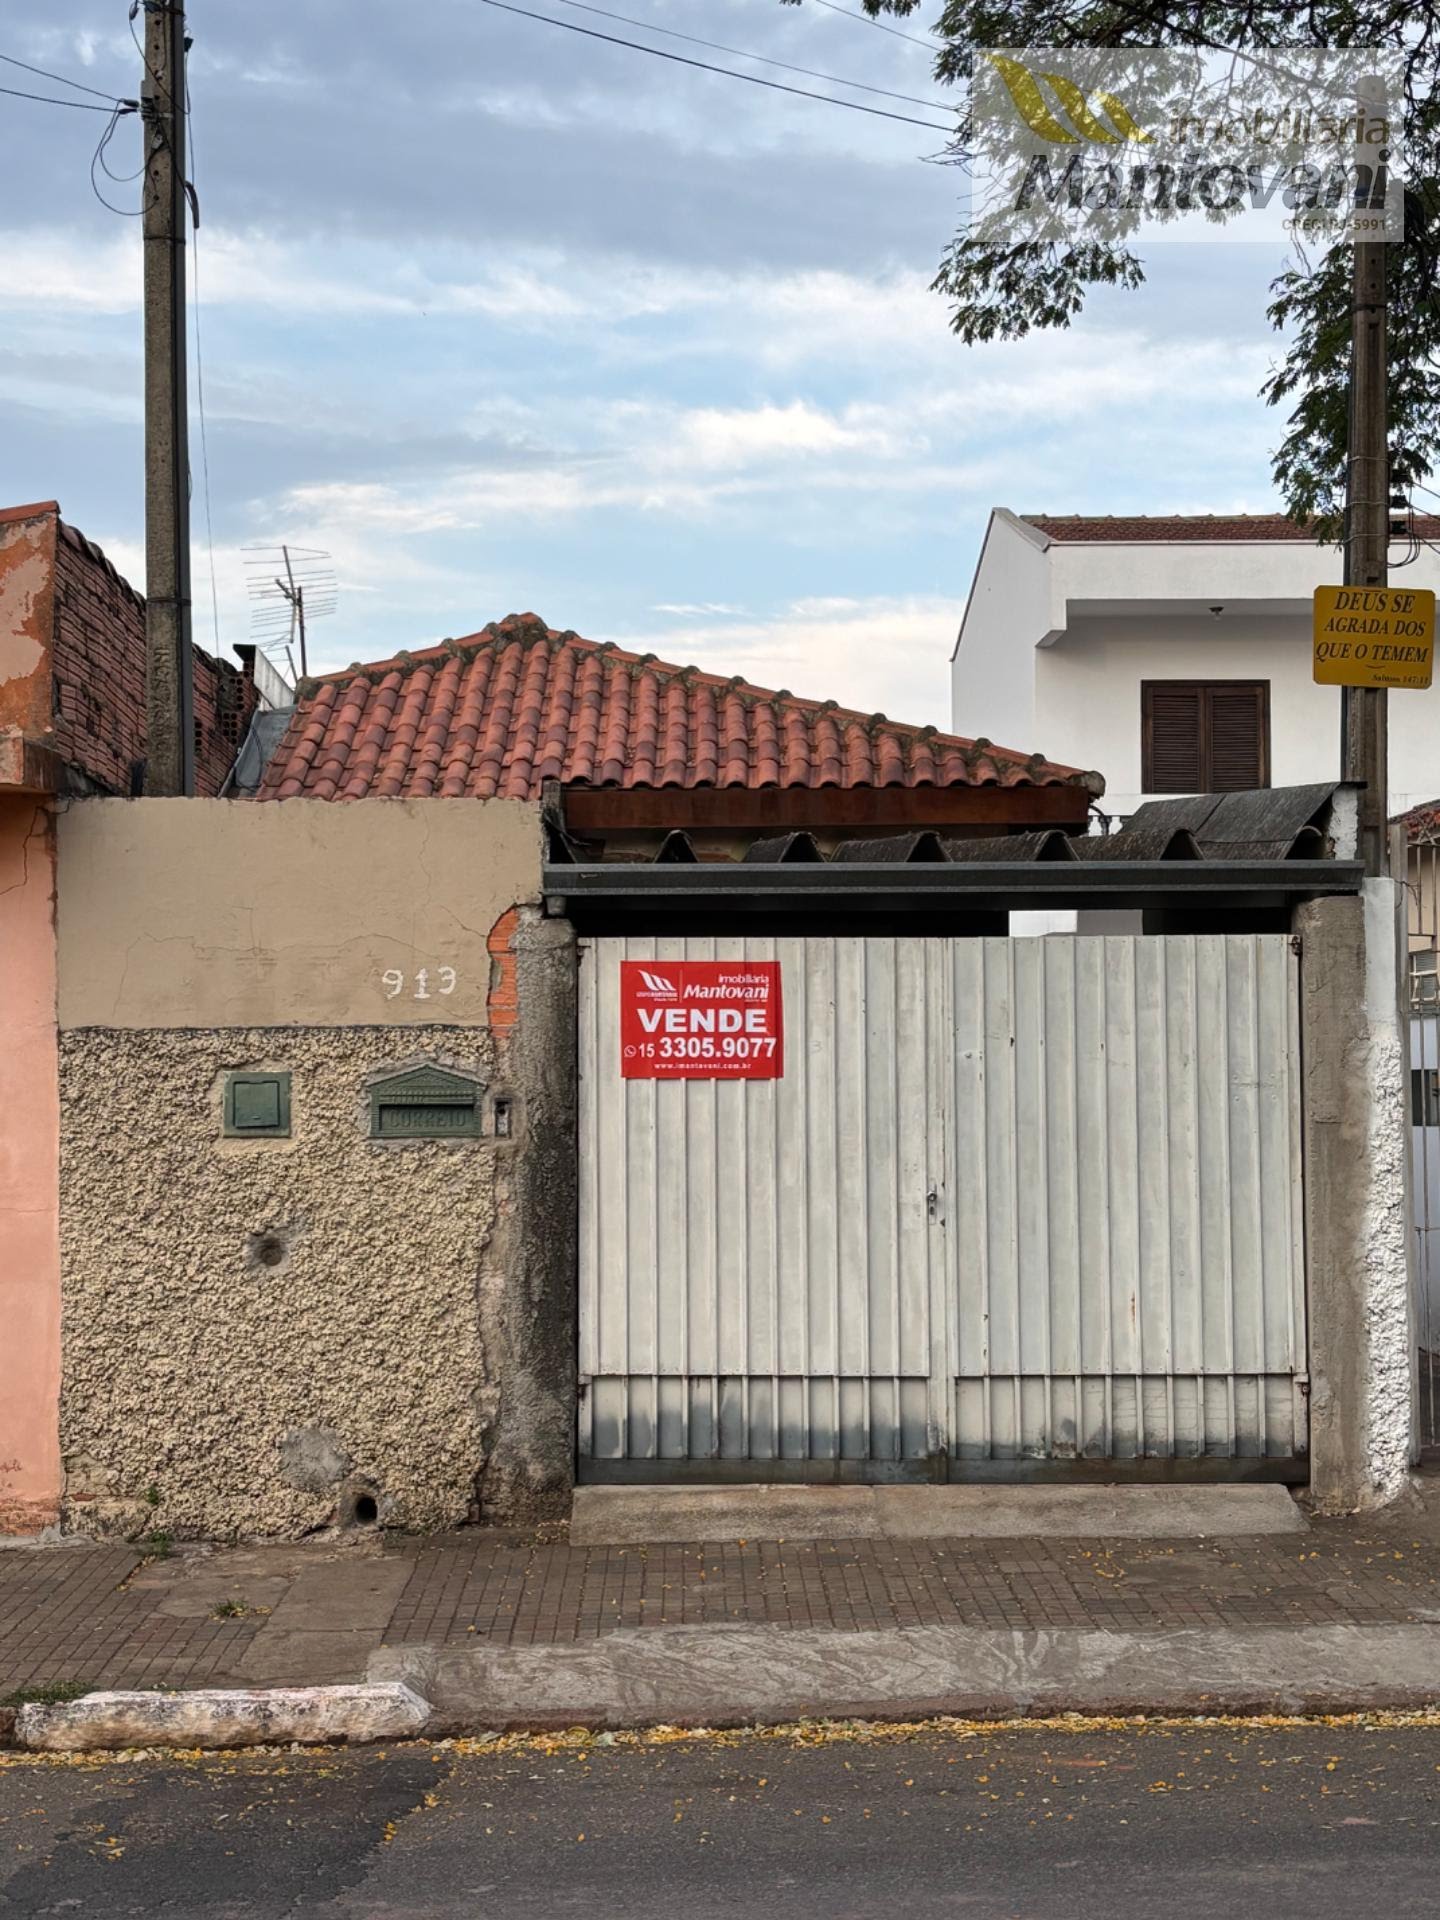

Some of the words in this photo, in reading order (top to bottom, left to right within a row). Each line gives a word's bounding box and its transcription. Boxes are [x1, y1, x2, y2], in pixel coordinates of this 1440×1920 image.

[1334, 591, 1389, 612] DEUS
[1391, 594, 1416, 614] SE
[1323, 616, 1389, 635] AGRADA
[1394, 620, 1426, 637] DOS
[1315, 641, 1352, 663] QUE
[1355, 643, 1369, 660] O
[1371, 644, 1430, 663] TEMEM
[382, 966, 456, 999] 913
[683, 984, 769, 999] Mantovani
[637, 1008, 768, 1033] VENDE
[638, 1043, 656, 1058] 15
[659, 1037, 777, 1058] 3305.9077
[389, 1110, 467, 1129] CORREIO
